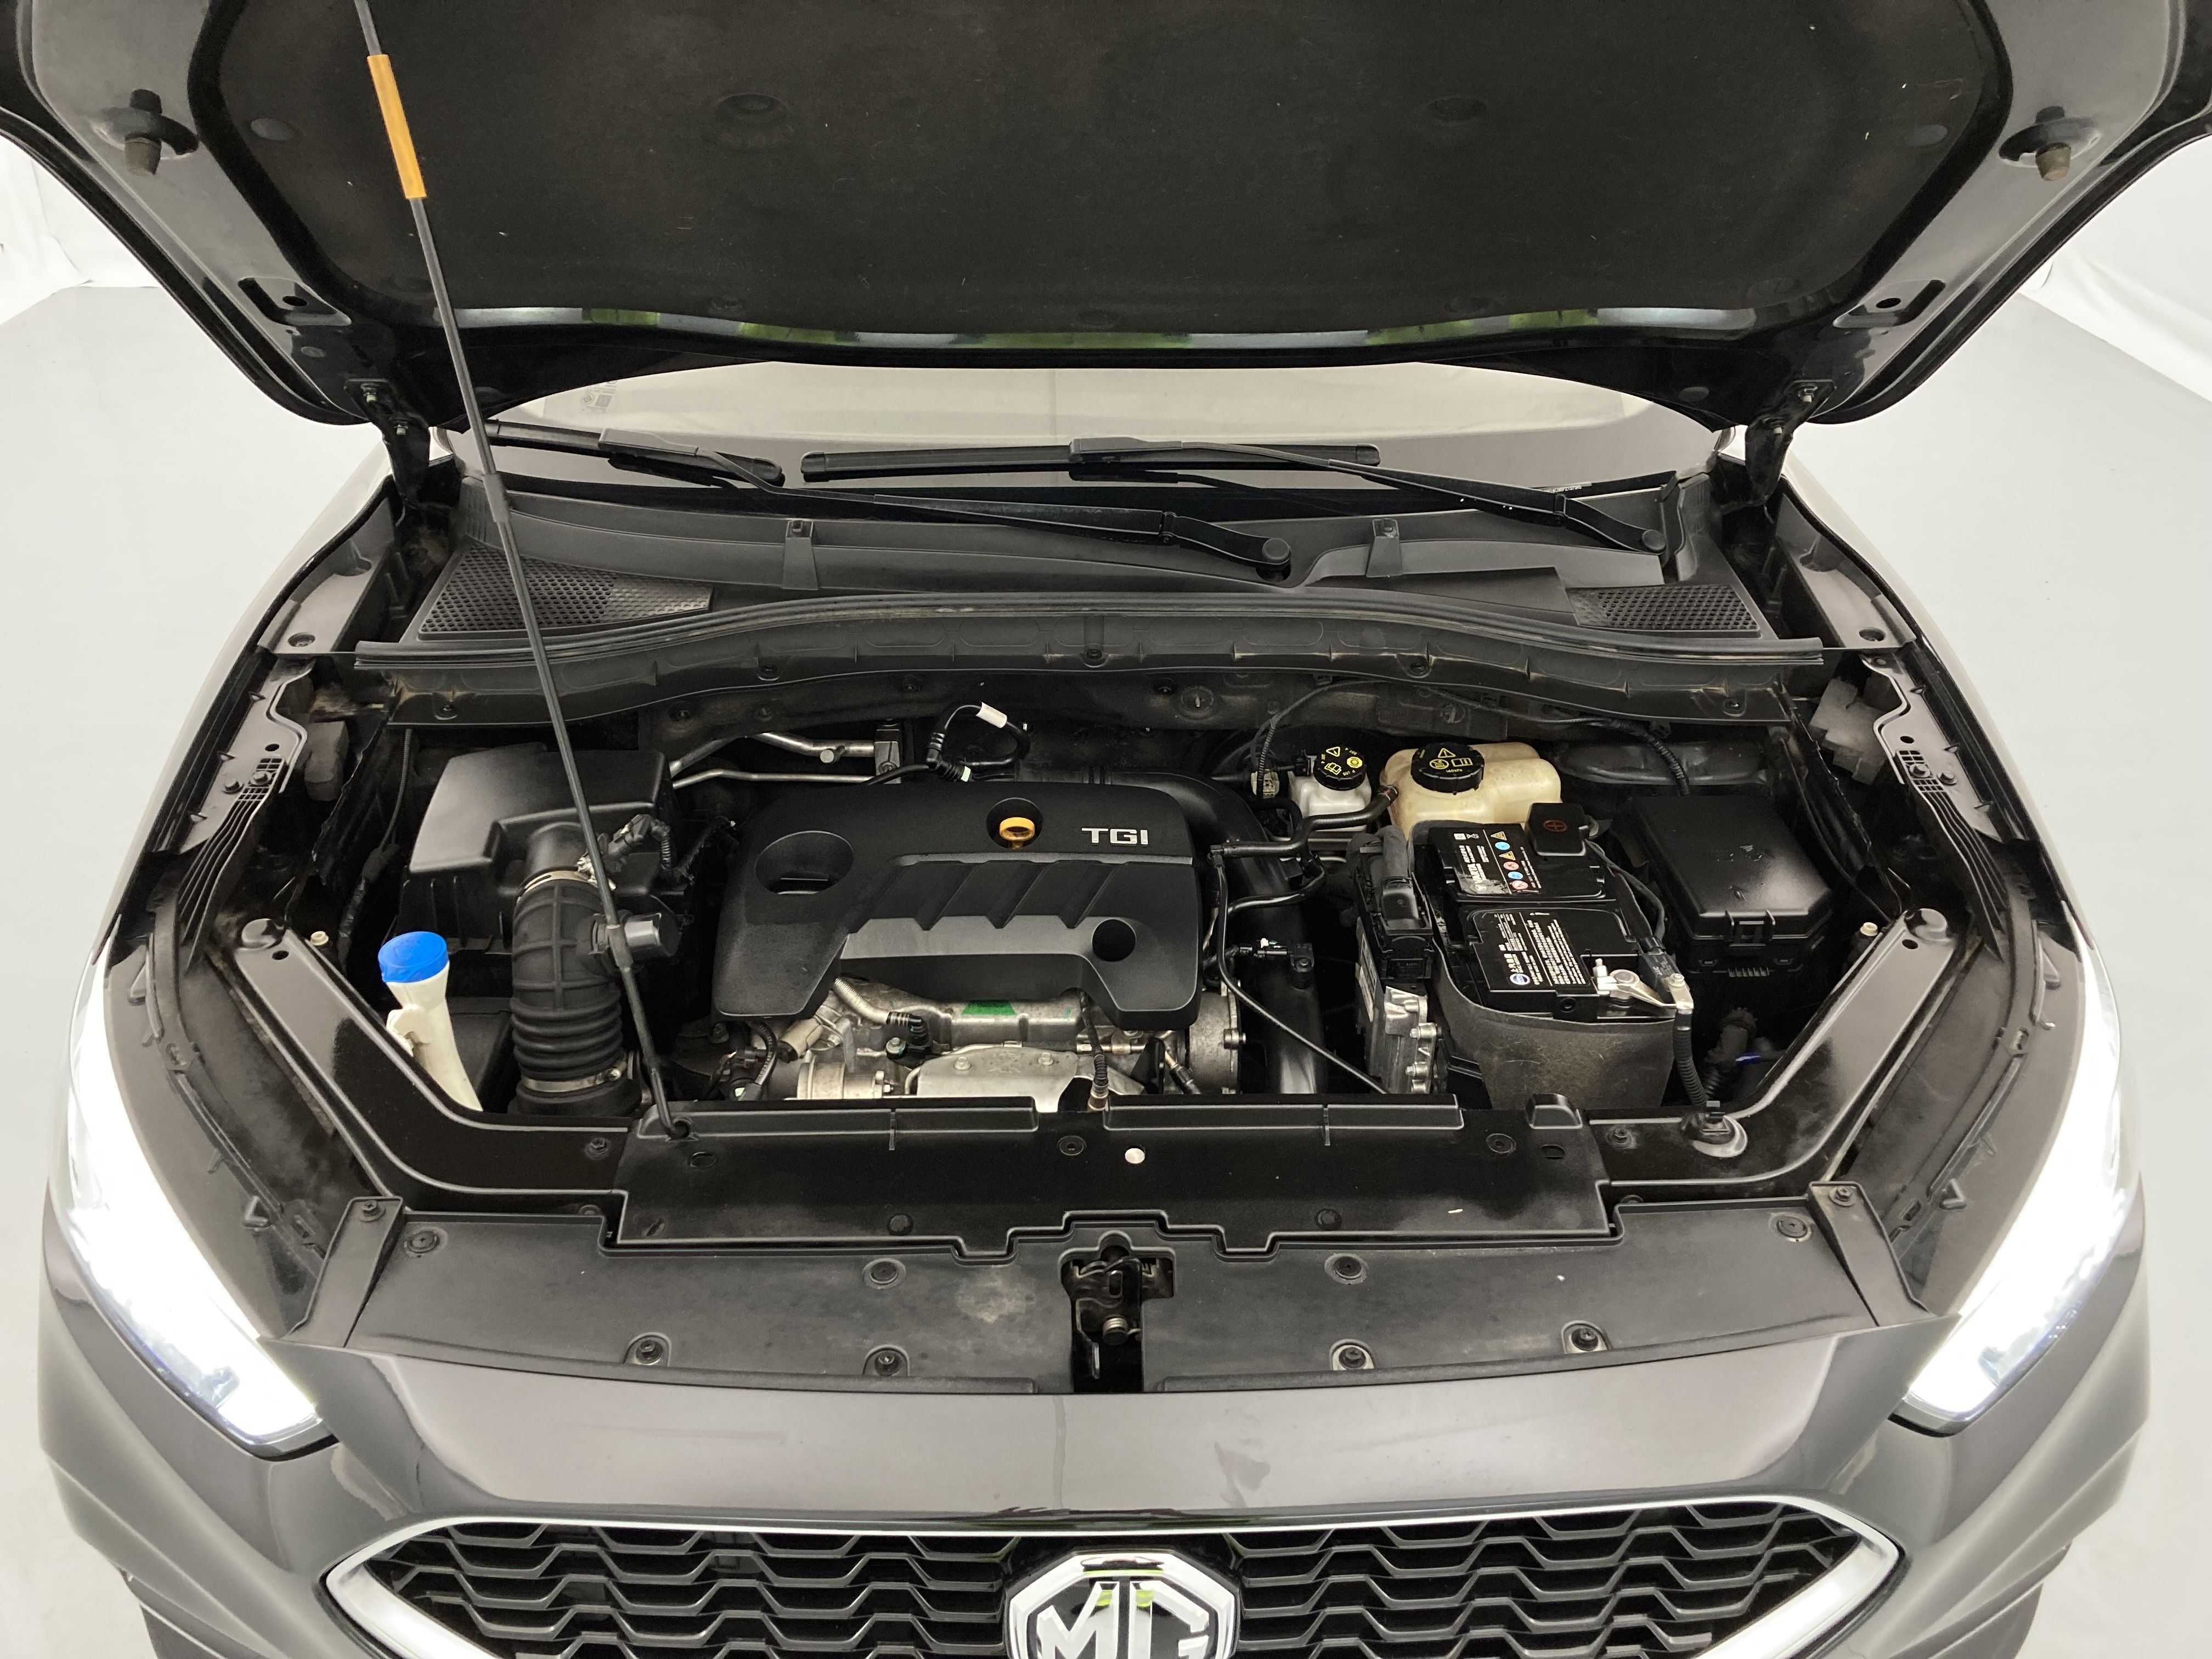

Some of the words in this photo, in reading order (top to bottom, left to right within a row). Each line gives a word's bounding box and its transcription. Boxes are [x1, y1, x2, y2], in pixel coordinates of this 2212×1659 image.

[1081, 827, 1149, 845] TGI
[1468, 864, 1482, 884] VARTA
[1036, 1580, 1209, 1659] MG
